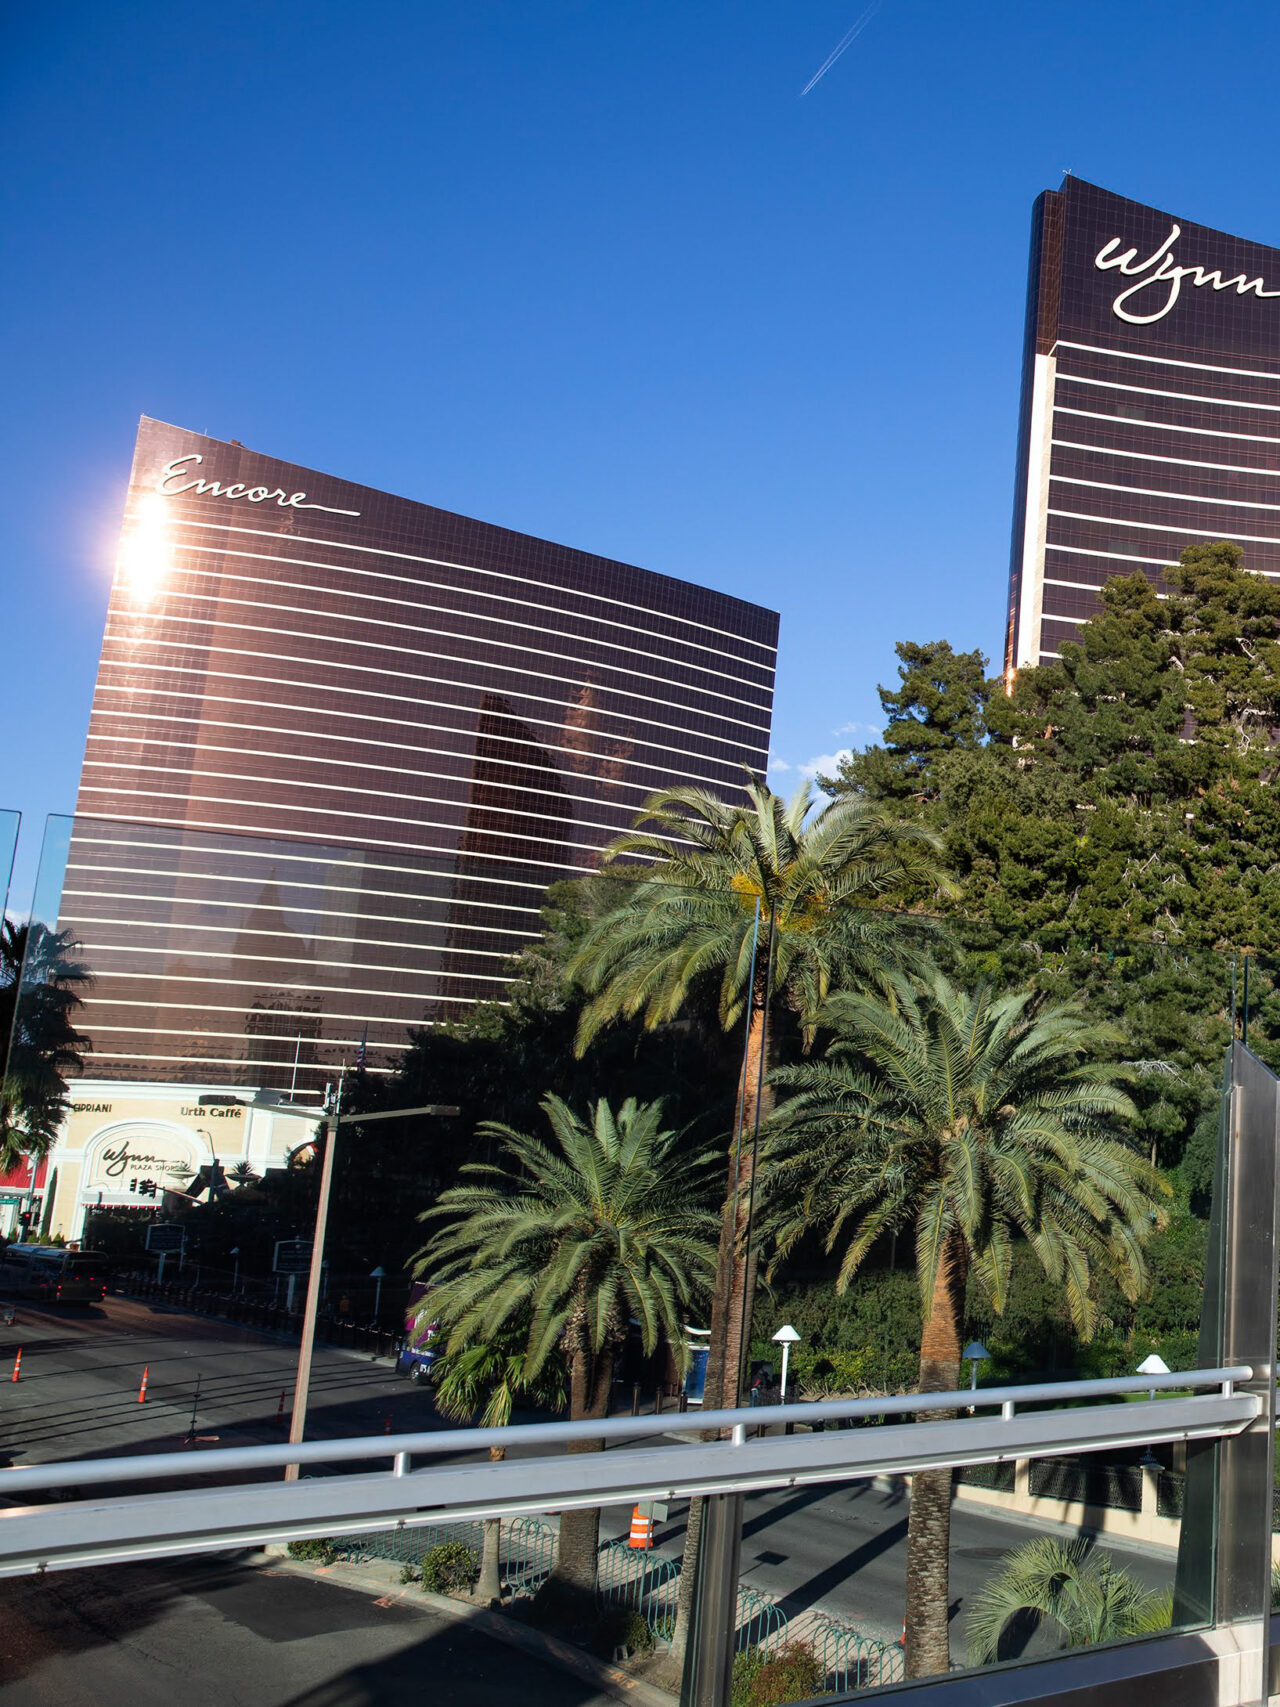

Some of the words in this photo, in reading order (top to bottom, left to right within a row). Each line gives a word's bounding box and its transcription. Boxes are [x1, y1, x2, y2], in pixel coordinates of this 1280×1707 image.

[155, 454, 361, 517] Encore
[73, 1103, 112, 1113] CIPRIANI
[180, 1106, 206, 1117] Urth
[209, 1107, 242, 1118] Caffé
